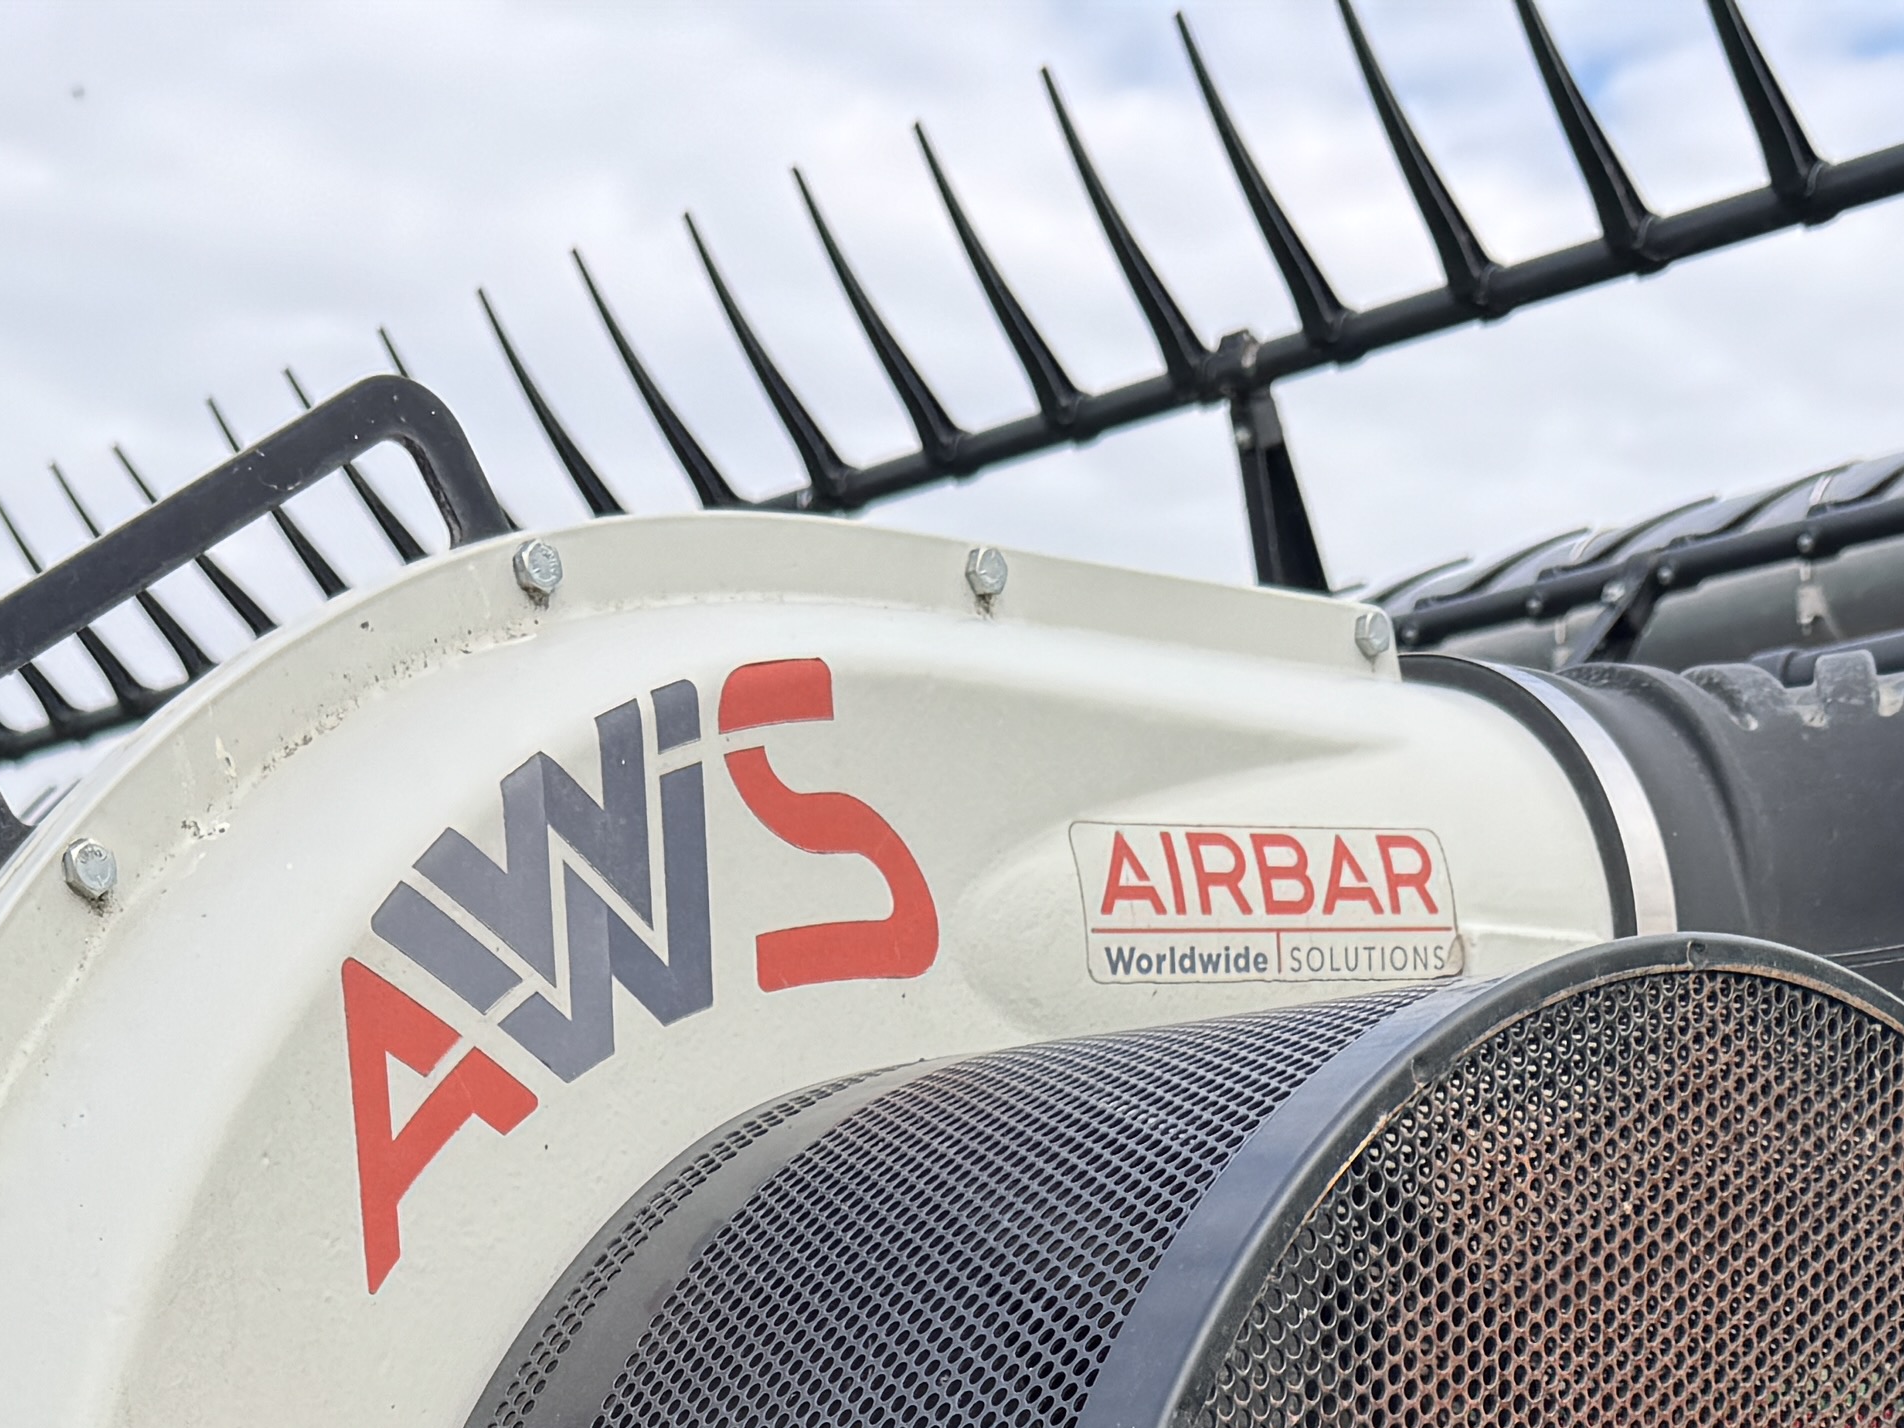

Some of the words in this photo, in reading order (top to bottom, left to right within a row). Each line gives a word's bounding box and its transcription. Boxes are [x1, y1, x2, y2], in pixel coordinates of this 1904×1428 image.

[1100, 830, 1439, 916] AIRBAR
[1104, 945, 1269, 976] Worldwide
[1289, 944, 1446, 973] SOLUTIONS
